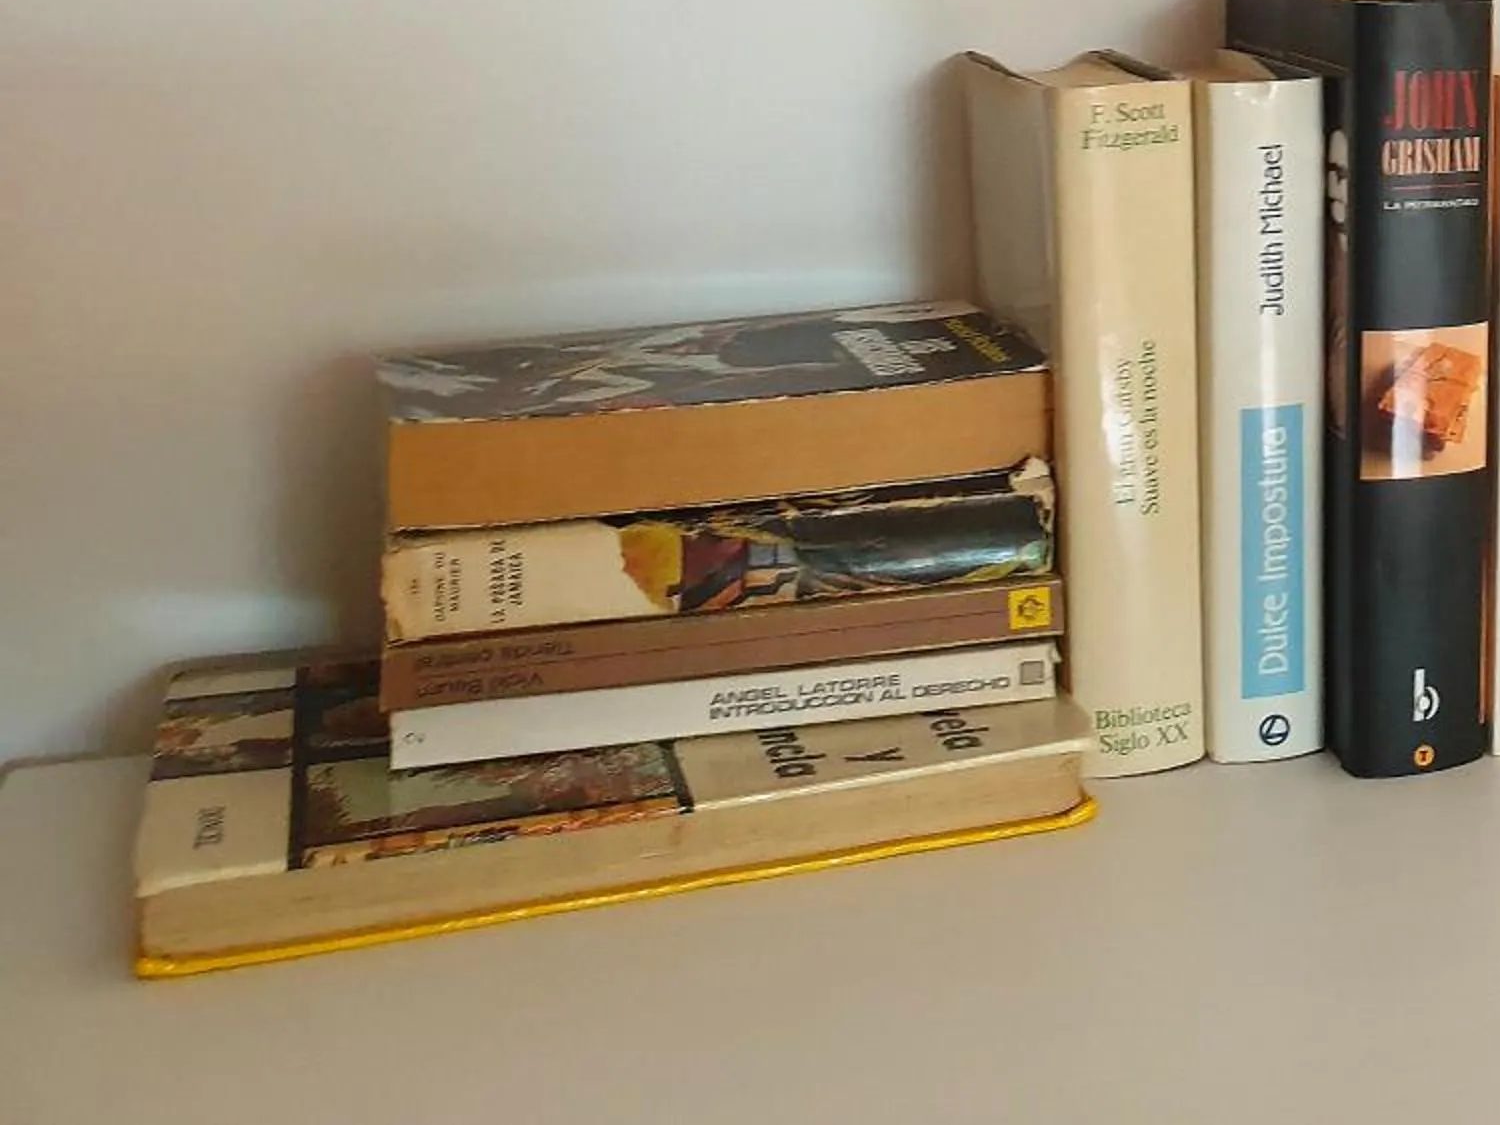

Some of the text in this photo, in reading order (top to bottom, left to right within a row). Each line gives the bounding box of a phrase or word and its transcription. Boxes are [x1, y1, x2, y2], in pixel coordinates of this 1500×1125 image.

[1091, 102, 1166, 124] F. Scott
[1384, 69, 1481, 132] JOHN
[1080, 124, 1181, 151] Fitzgerald
[1381, 136, 1481, 176] GRISHAM
[1257, 144, 1285, 316] Judith Michael
[1137, 339, 1161, 516] Suave es la noche
[1257, 425, 1292, 675] Dulce Impostura
[709, 676, 1011, 720] INTRODUCCION AL DERECHO
[711, 674, 901, 705] ANGEL LATORRE
[1094, 701, 1192, 730] Biblioteca
[1099, 723, 1189, 756] Siglo XX
